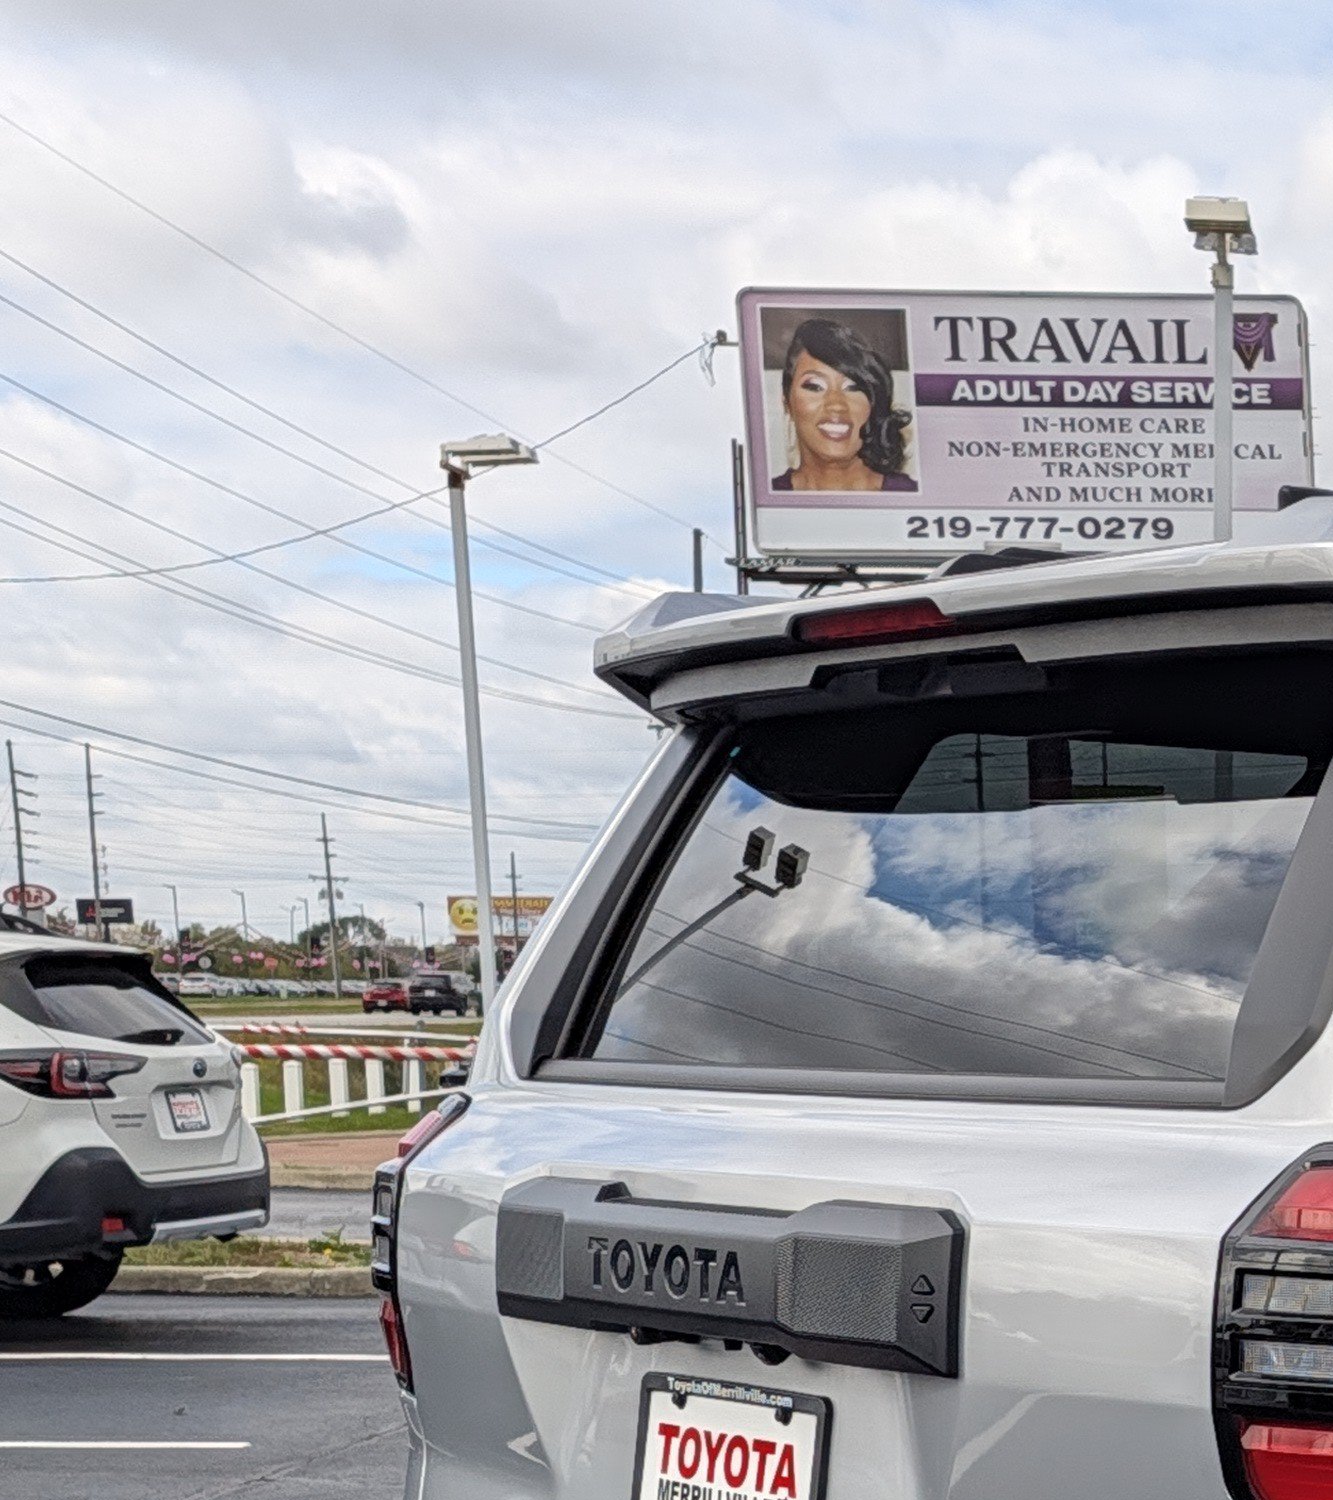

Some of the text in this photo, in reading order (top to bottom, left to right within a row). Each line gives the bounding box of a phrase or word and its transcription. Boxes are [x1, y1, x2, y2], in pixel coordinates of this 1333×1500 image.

[933, 315, 1208, 365] TRAVAIL
[951, 379, 1273, 405] ADULT DAY SERVCE
[1022, 416, 1206, 434] IN-HOME CARE
[948, 440, 1164, 459] NON-EMERGENCY
[1041, 462, 1192, 479] TRANSPORT
[1007, 487, 1062, 502] AND
[1068, 487, 1143, 503] MUCH
[906, 516, 1175, 540] 219-777-0279
[587, 1236, 746, 1307] TOYOTA
[658, 1422, 797, 1499] TOYOTA
